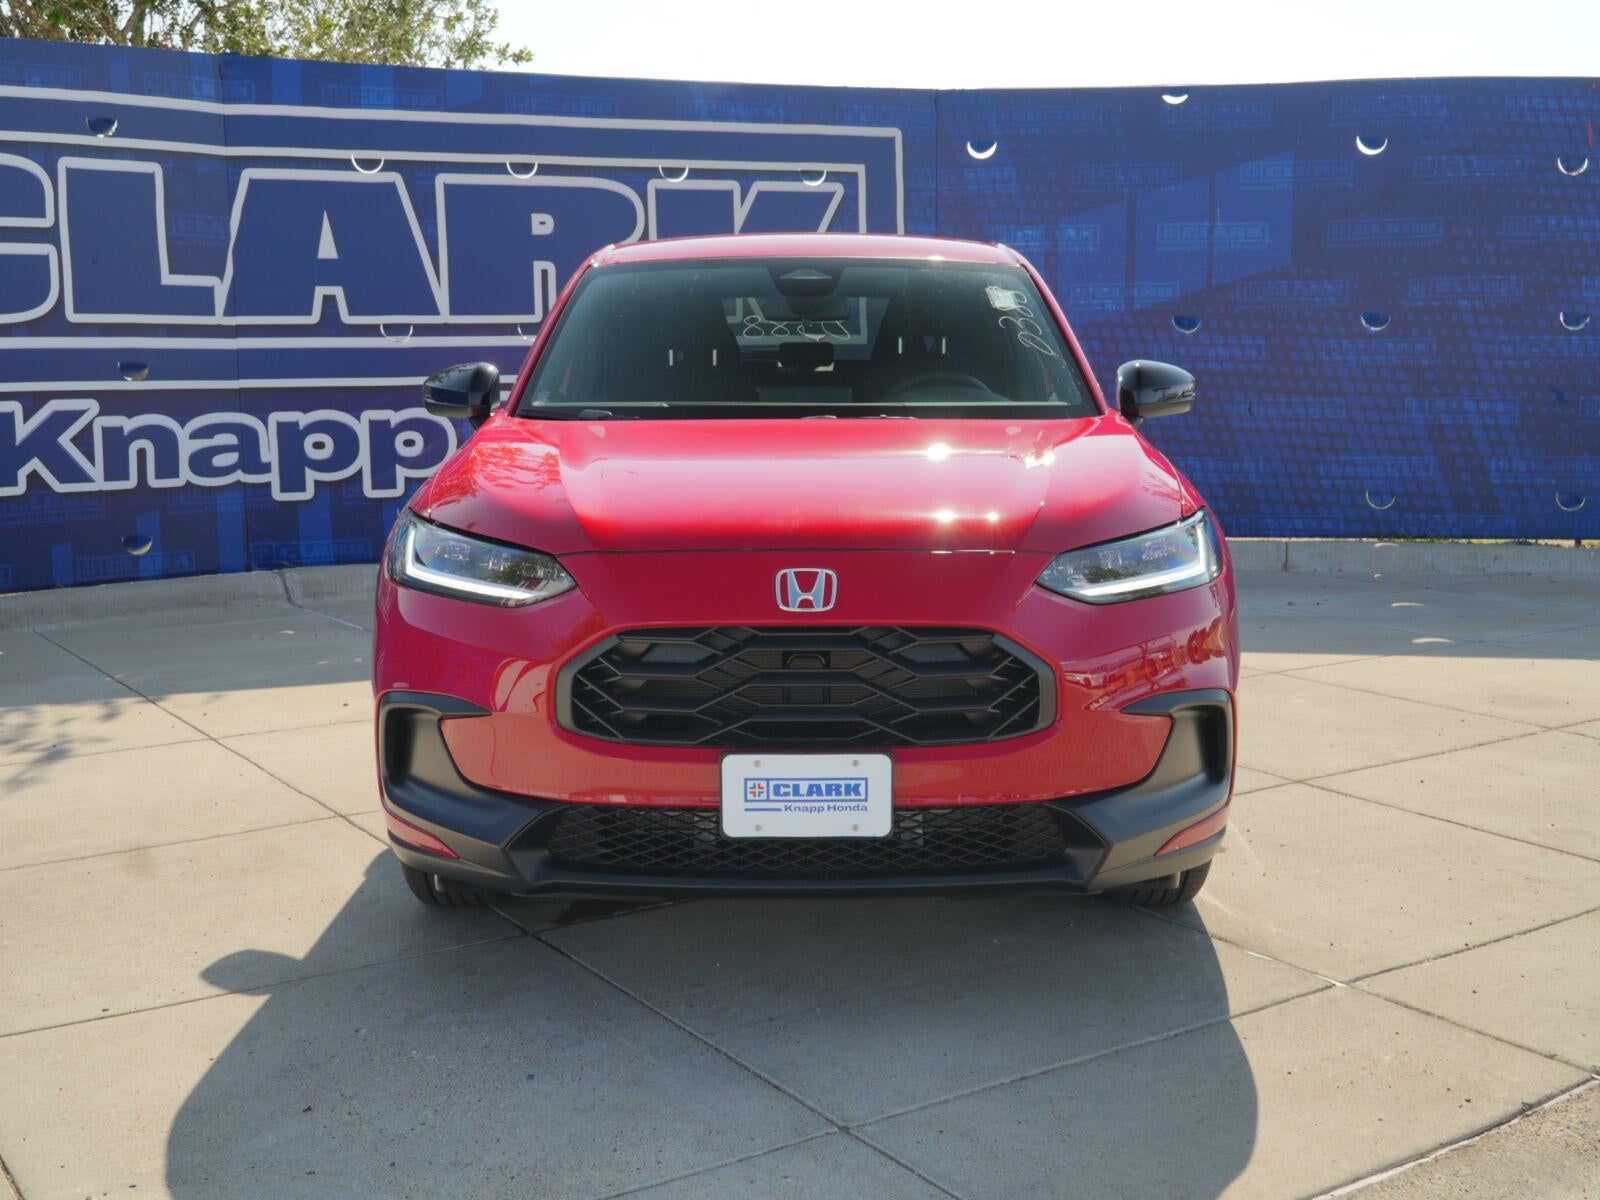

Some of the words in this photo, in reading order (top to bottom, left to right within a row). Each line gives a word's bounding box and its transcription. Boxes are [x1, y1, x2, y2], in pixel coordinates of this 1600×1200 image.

[0, 398, 457, 501] Knapp
[773, 783, 862, 797] CLARK
[784, 804, 825, 814] Knapp
[827, 804, 868, 812] Honda
